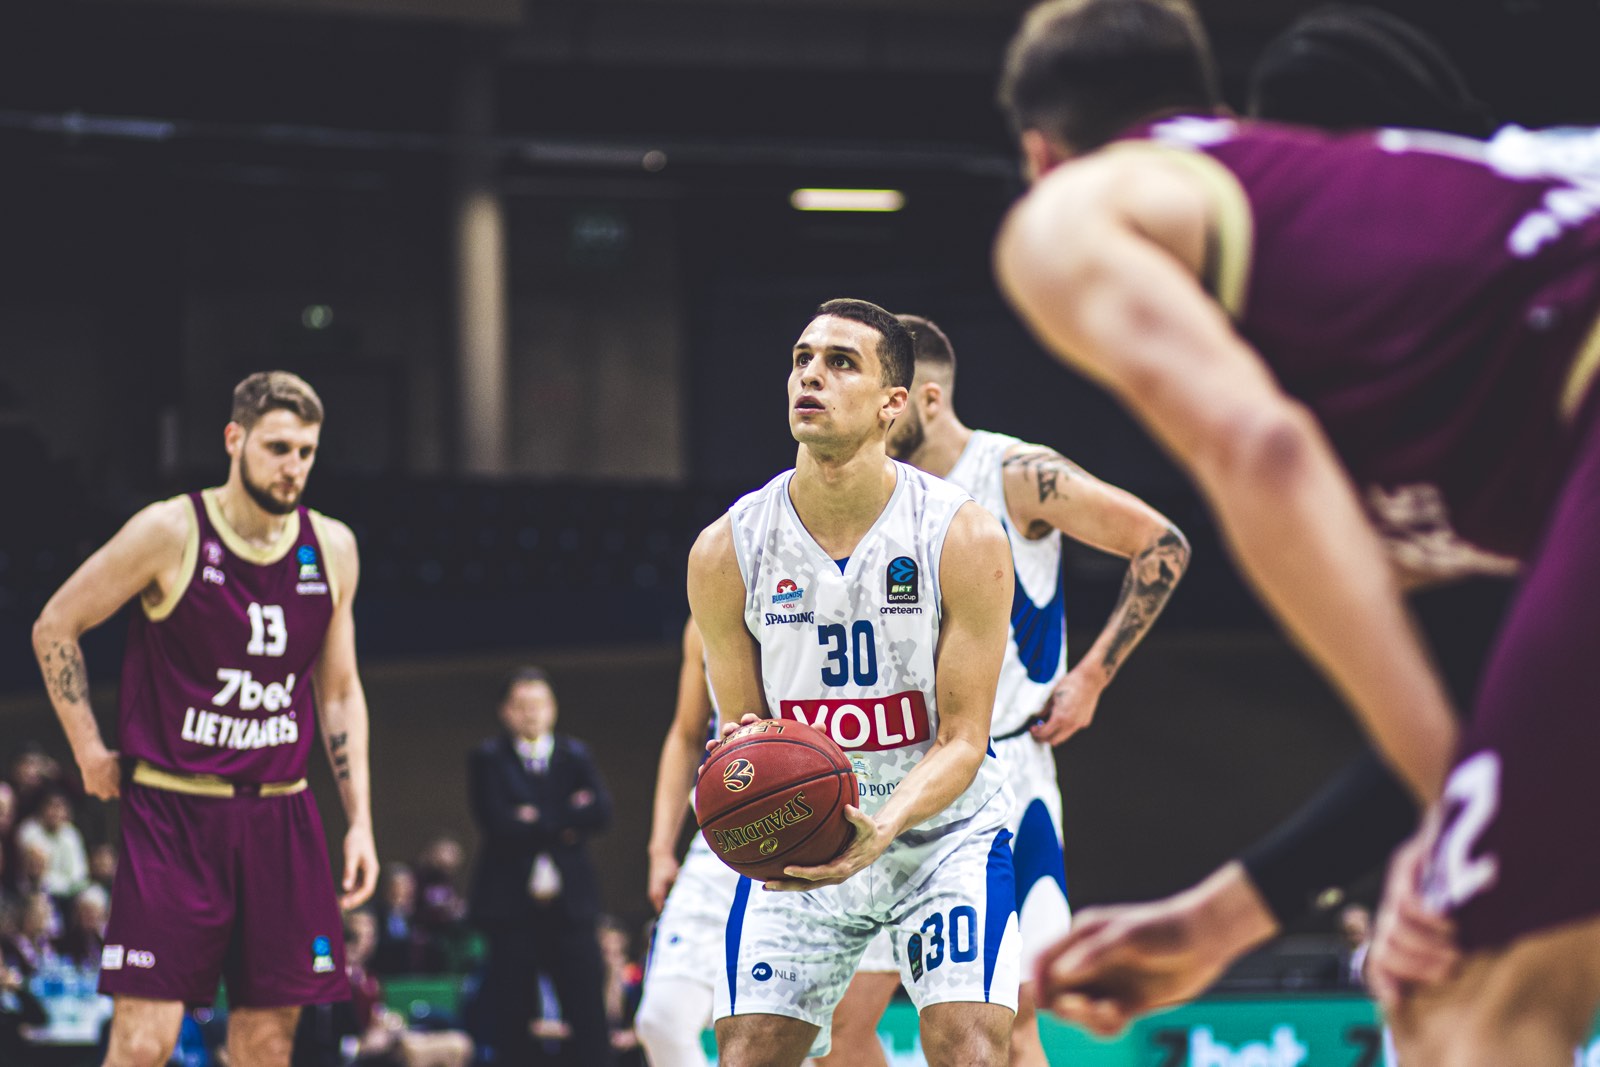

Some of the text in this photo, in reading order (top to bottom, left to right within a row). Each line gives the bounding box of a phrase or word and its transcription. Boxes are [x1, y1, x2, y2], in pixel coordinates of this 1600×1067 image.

[888, 593, 917, 602] EuroCup
[247, 602, 288, 657] 13
[765, 611, 815, 626] SPALDING
[817, 619, 878, 687] 30
[869, 781, 900, 797] POD
[712, 791, 814, 853] SPALDING
[920, 905, 978, 971] 30
[774, 968, 797, 982] NLB
